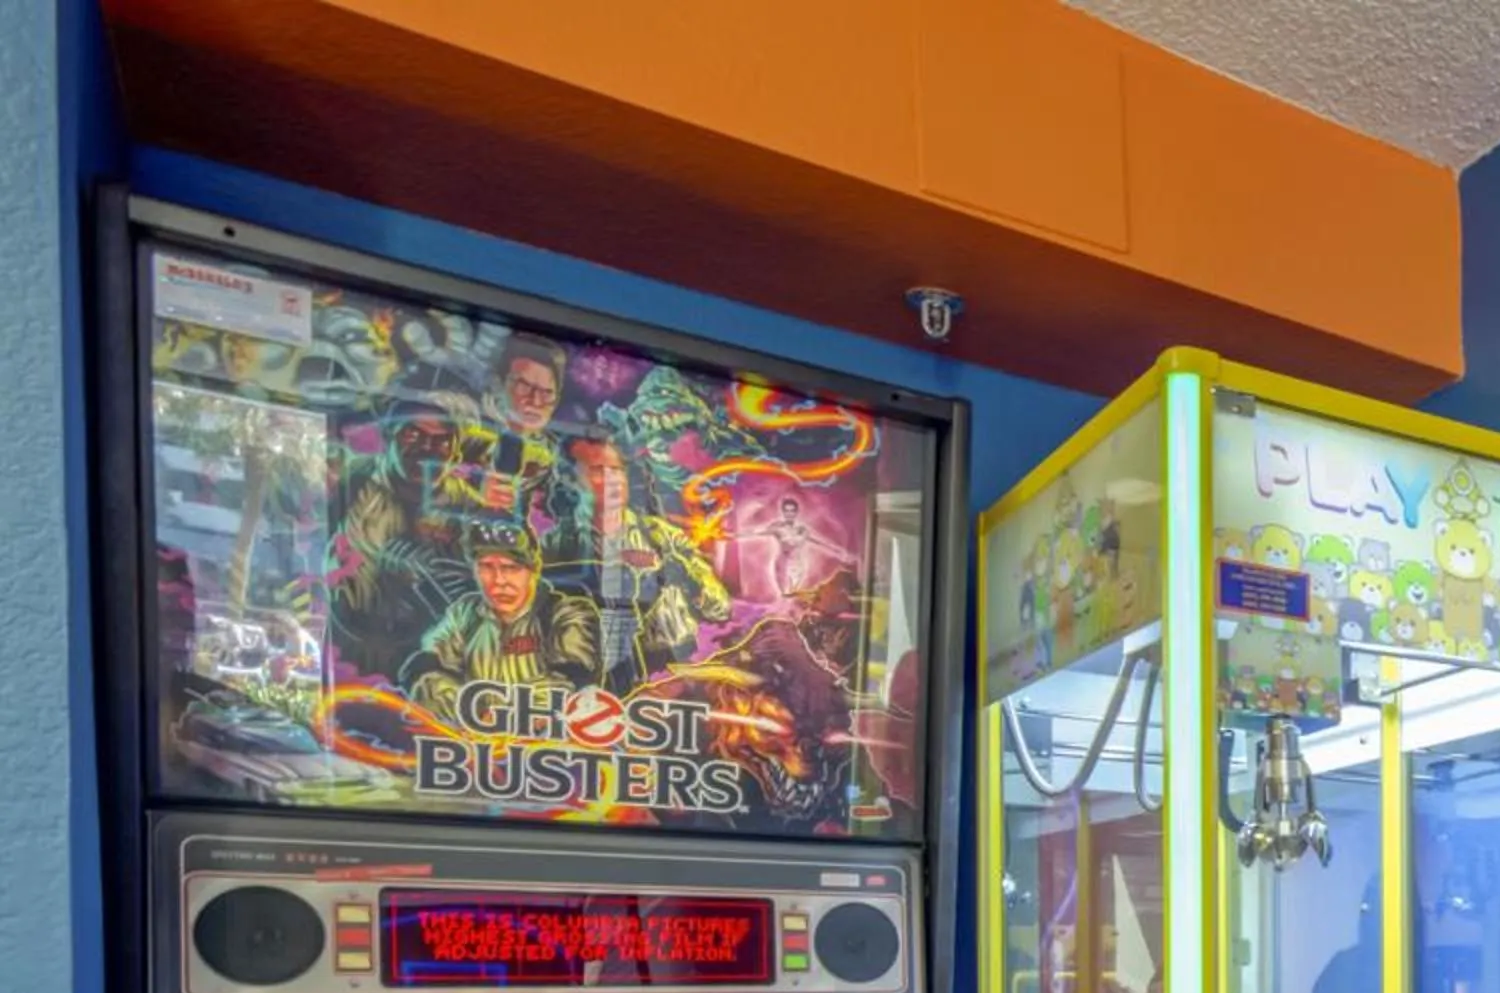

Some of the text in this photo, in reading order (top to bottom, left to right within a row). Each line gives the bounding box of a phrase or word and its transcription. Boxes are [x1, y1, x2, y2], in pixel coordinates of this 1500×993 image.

[1254, 428, 1430, 529] PLAY
[456, 680, 710, 754] GHOST
[413, 735, 744, 813] BUSTERS
[418, 911, 475, 930] THIS
[485, 913, 513, 931] IS
[522, 914, 641, 934] COLUMBIA
[423, 928, 527, 946] HIGHEST
[434, 944, 556, 962] ADJUSTED
[563, 945, 609, 962] FOR
